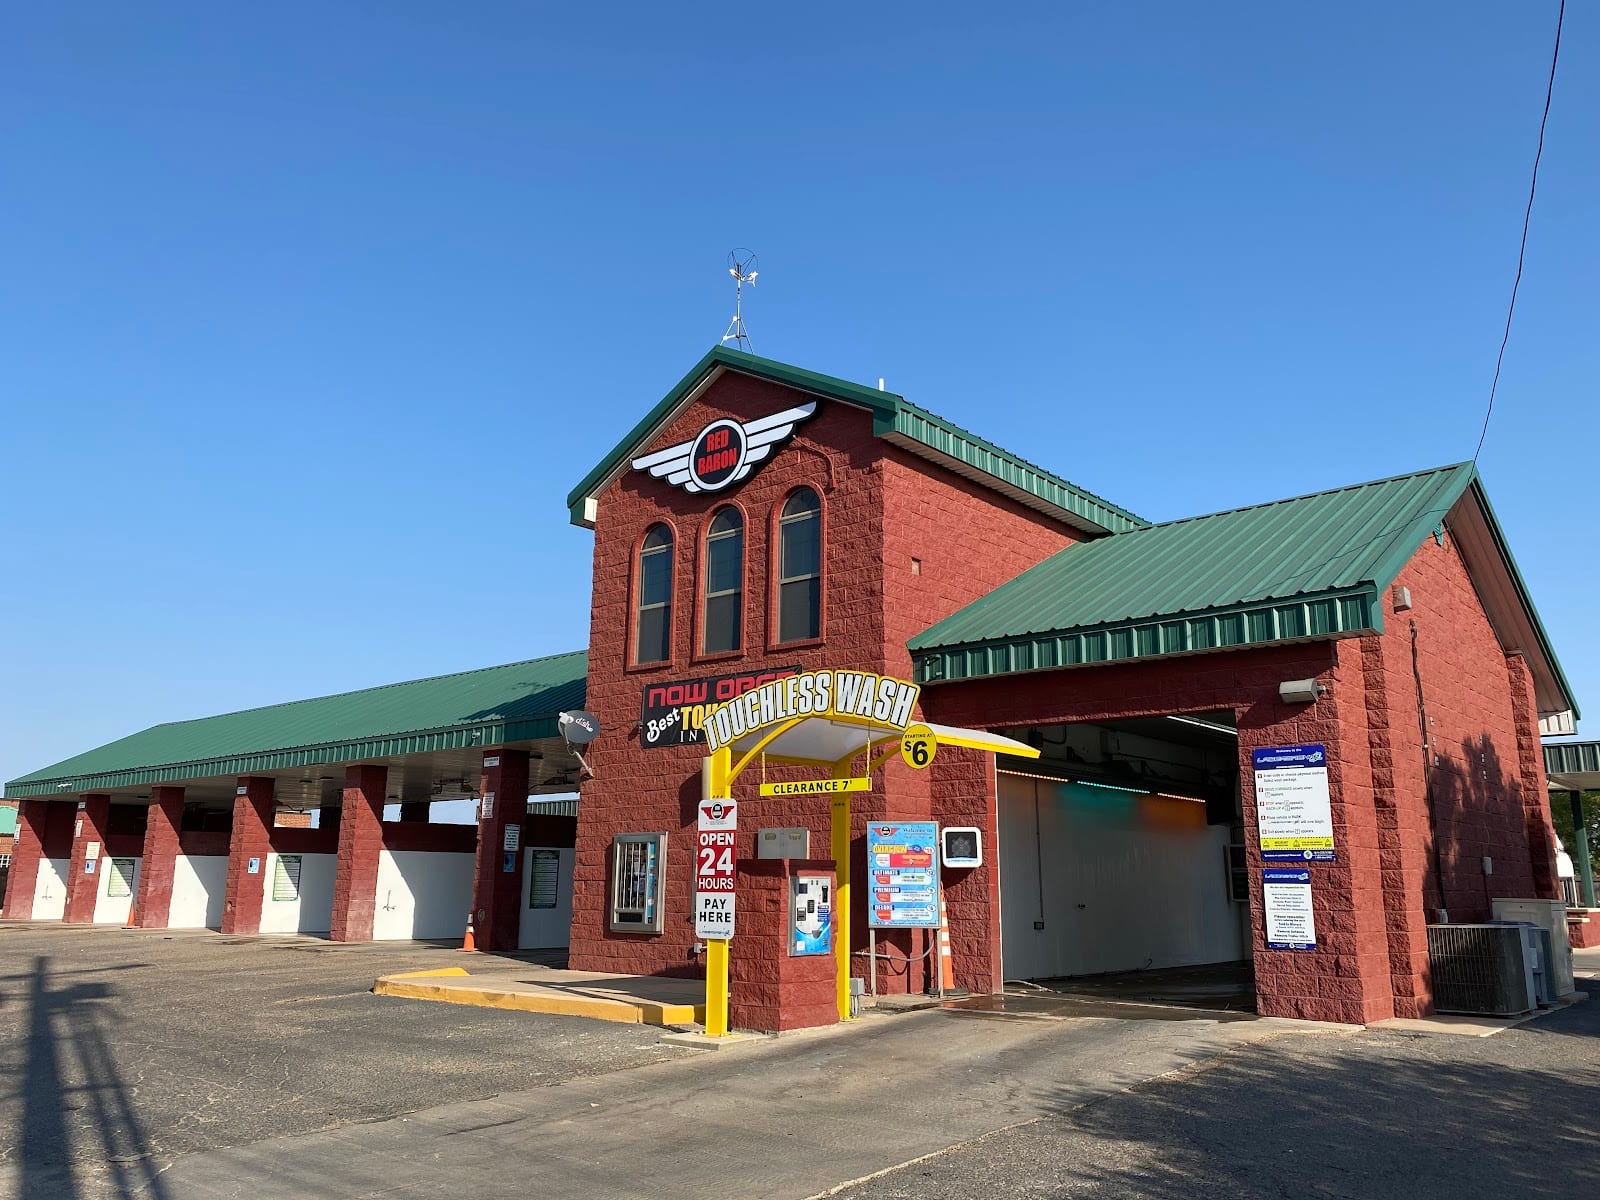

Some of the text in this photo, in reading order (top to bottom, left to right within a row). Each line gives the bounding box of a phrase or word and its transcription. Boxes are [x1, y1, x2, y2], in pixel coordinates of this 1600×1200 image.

[707, 429, 729, 452] RED
[697, 448, 737, 475] BARON
[648, 671, 796, 708] NOW OP
[702, 672, 917, 751] TOUCHLESS WASH
[575, 717, 592, 731] dish
[646, 707, 681, 743] Best
[680, 730, 698, 743] IN
[773, 781, 838, 794] CLEARANCE
[699, 832, 735, 846] OPEN
[699, 847, 734, 876] 24
[698, 878, 734, 890] HOURS
[704, 898, 727, 910] PAY
[699, 911, 731, 923] HERE
